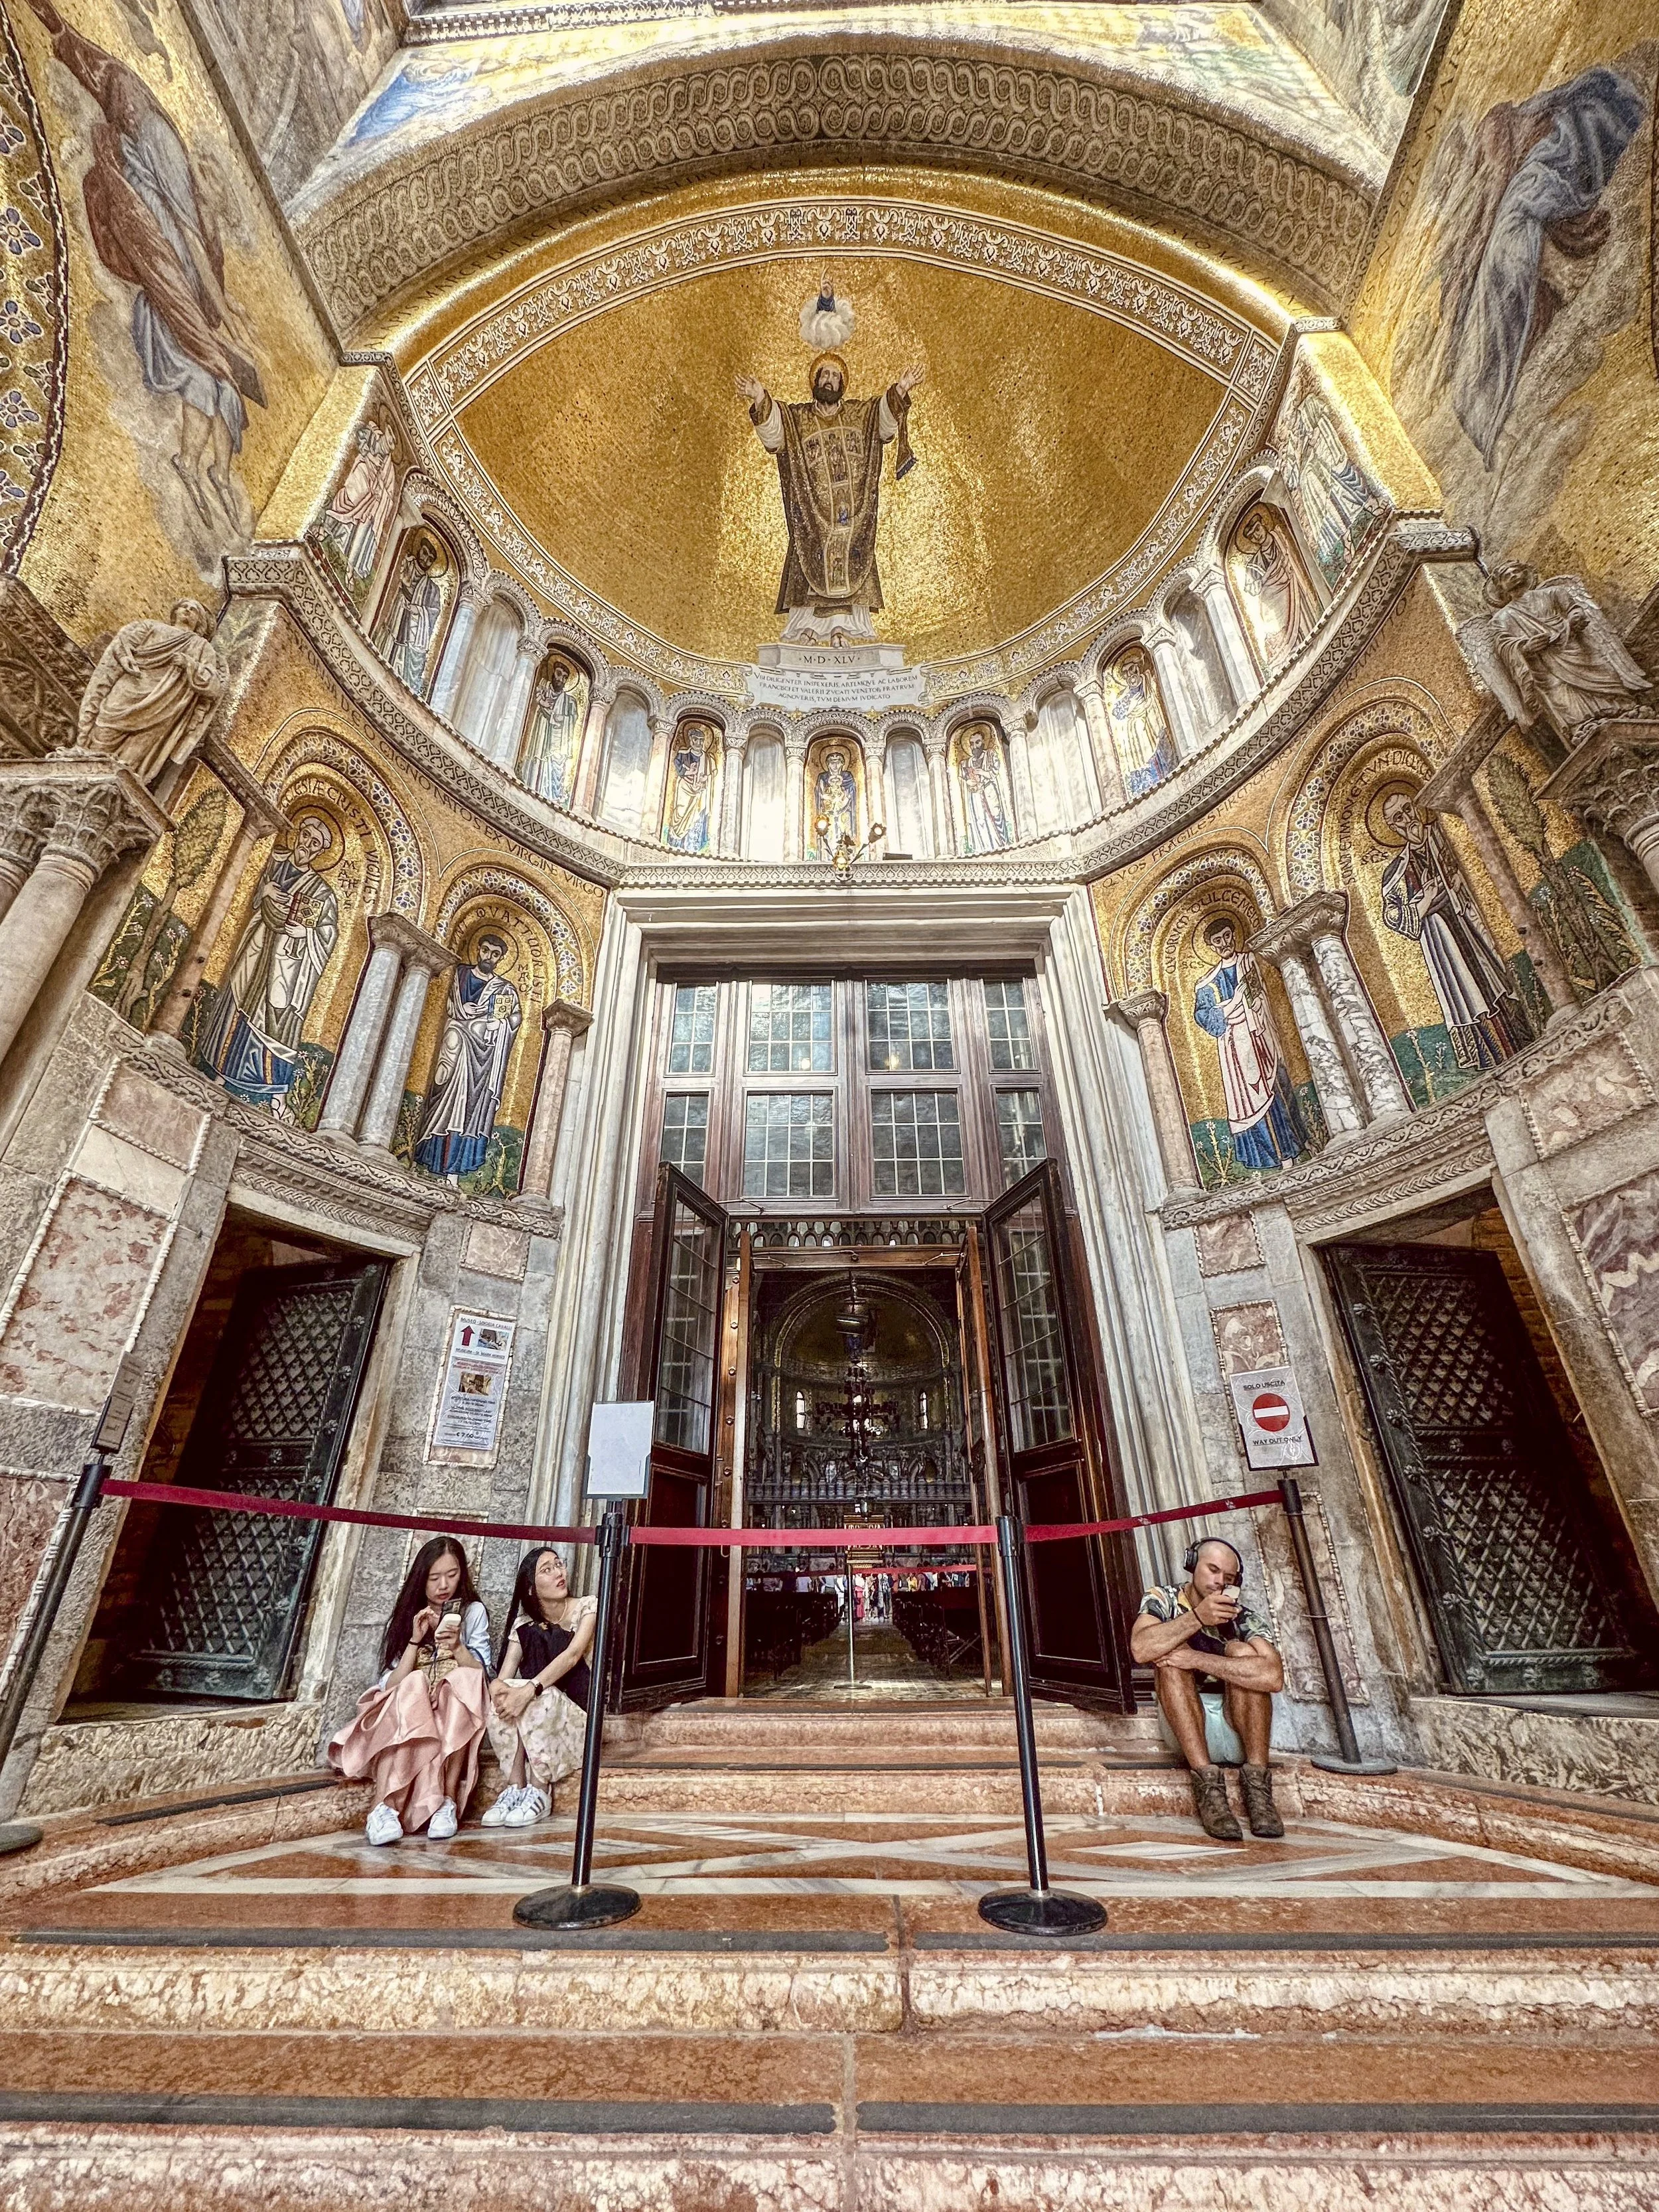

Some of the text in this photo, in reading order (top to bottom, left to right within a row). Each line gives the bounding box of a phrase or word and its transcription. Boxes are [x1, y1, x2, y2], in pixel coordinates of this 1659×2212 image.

[888, 675, 918, 684] LABOREM
[327, 787, 372, 838] CRISTI
[483, 827, 502, 844] EX
[564, 870, 605, 898] VIRGO
